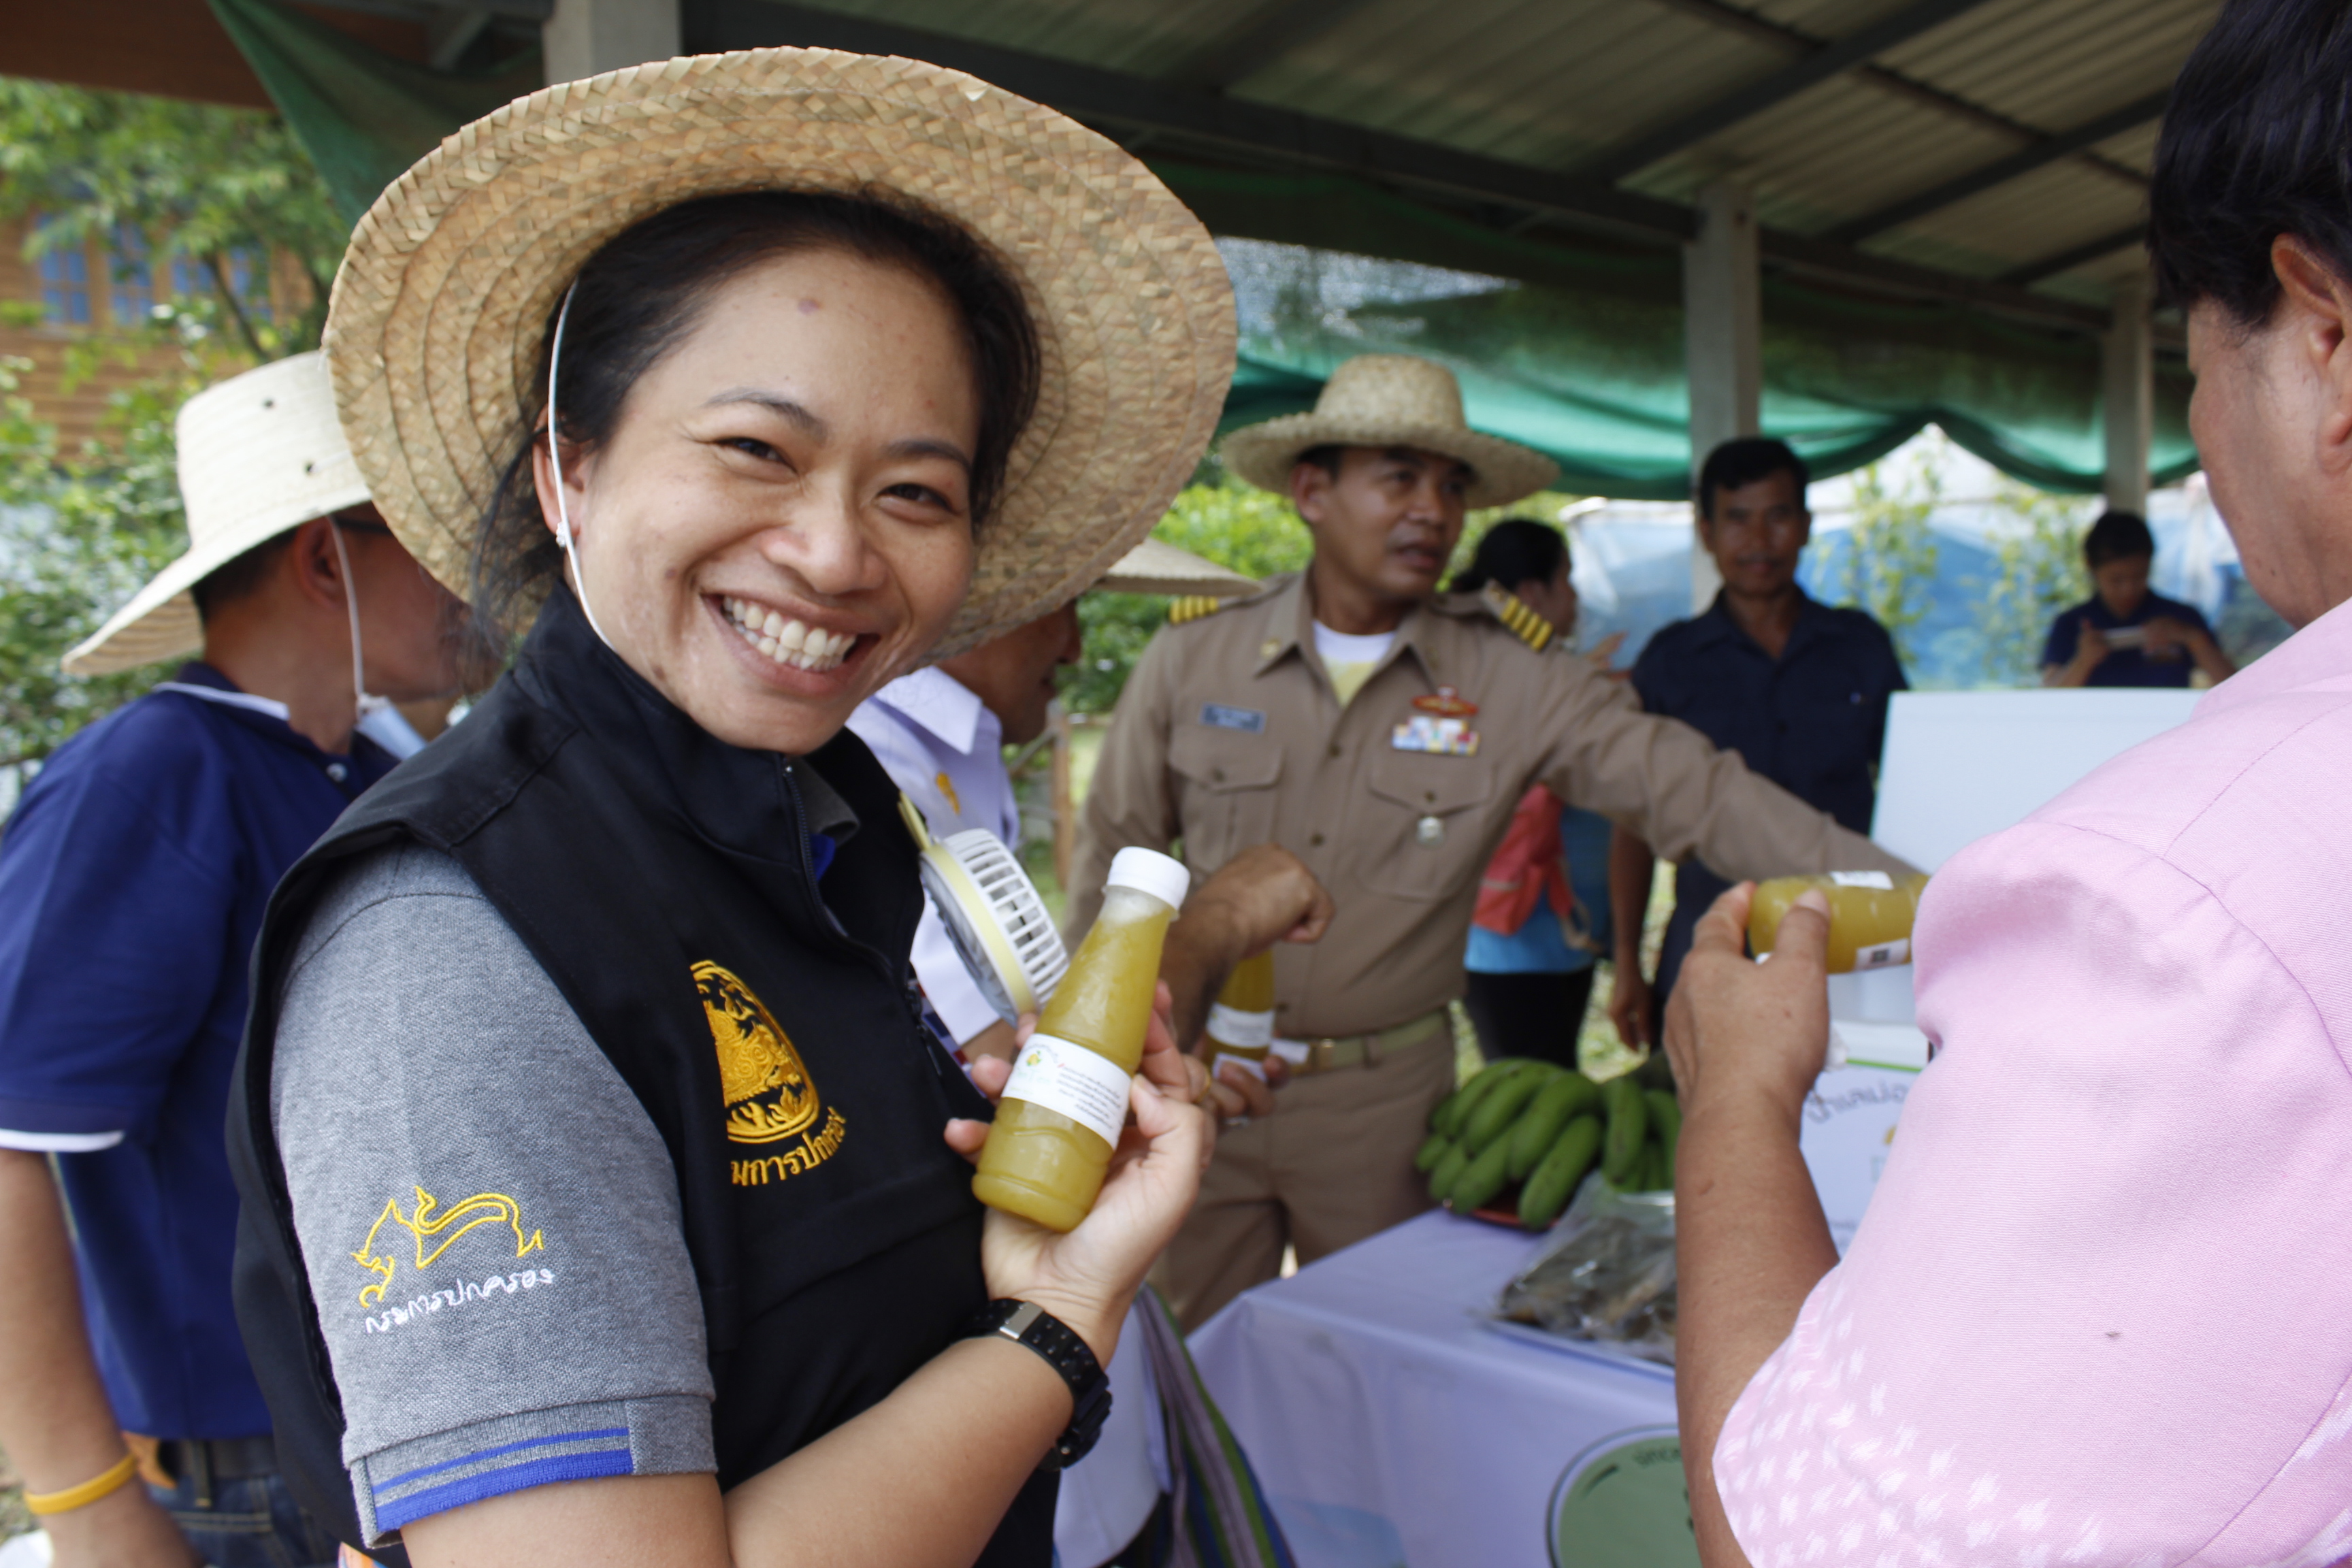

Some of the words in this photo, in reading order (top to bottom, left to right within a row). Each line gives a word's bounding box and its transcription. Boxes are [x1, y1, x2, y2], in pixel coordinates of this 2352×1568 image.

[364, 1268, 556, 1334] กรมการปกครอง
